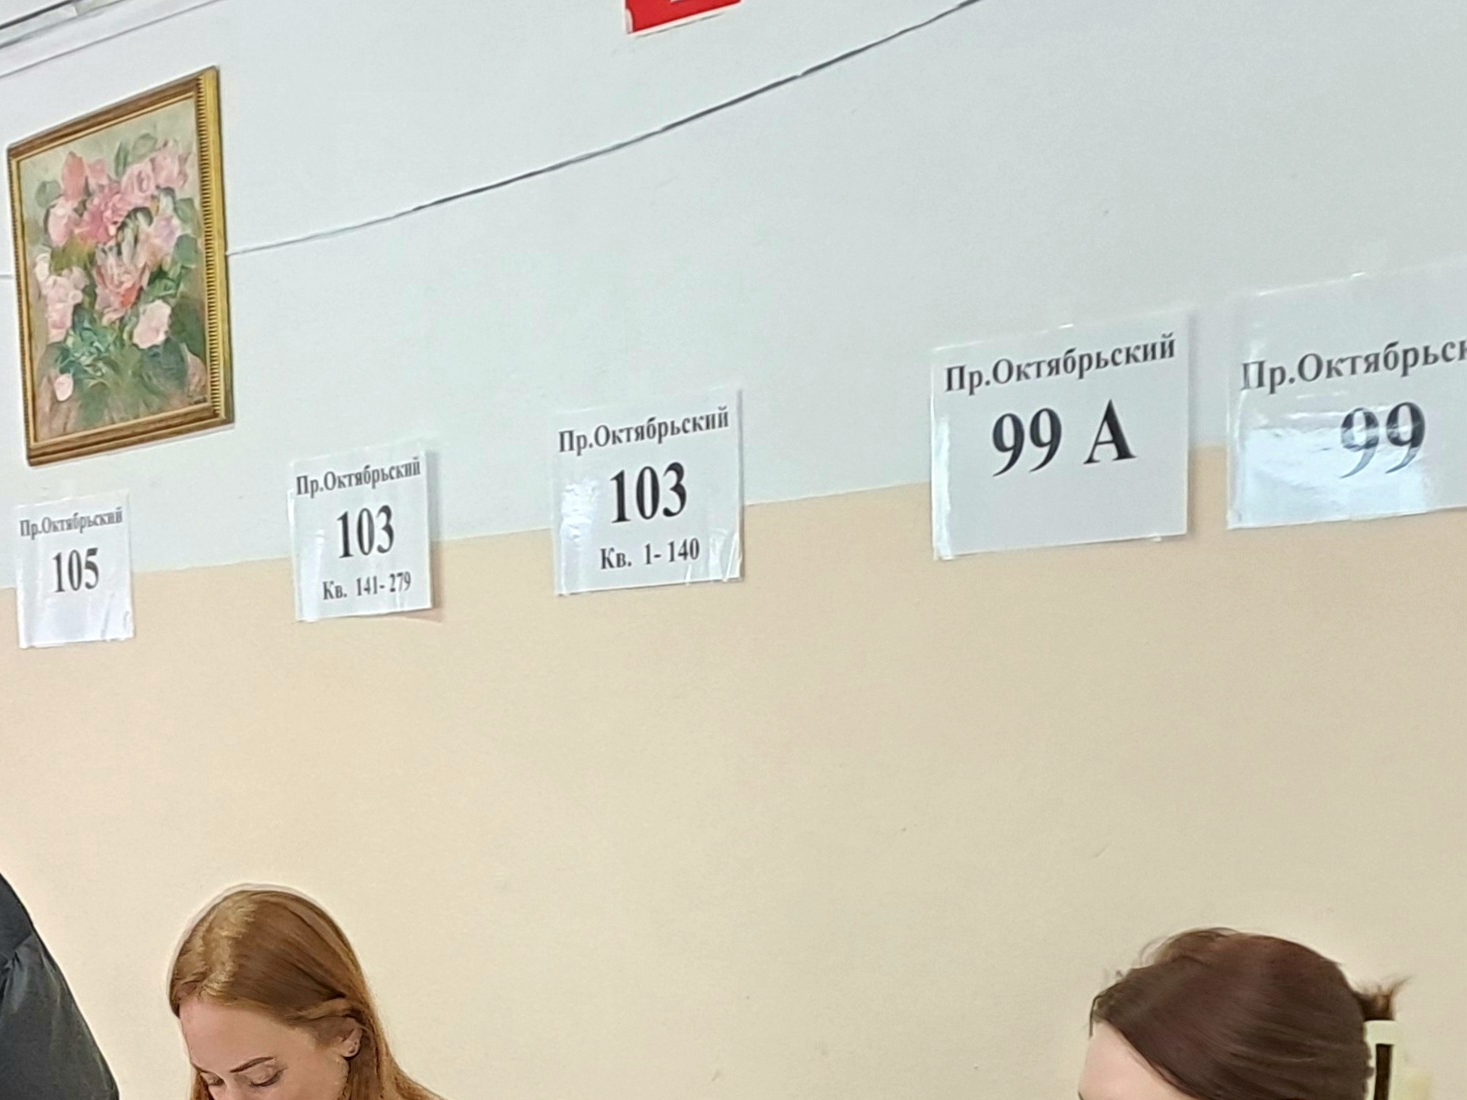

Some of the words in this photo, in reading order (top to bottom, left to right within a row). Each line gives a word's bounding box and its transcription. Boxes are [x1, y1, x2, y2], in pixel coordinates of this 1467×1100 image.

[944, 333, 1176, 395] Пр.Октябрьский
[558, 405, 729, 456] Пр.Октябрьский
[992, 407, 1062, 478] 99
[1083, 399, 1137, 465] А
[1339, 402, 1426, 478] 99
[297, 456, 421, 498] Пр.Октябрьский
[610, 462, 687, 523] 103
[20, 506, 123, 540] Пр.Октябрьский
[337, 505, 394, 558] 103
[52, 547, 100, 593] 105
[600, 547, 632, 569] Кв.
[323, 580, 348, 600] Кв.
